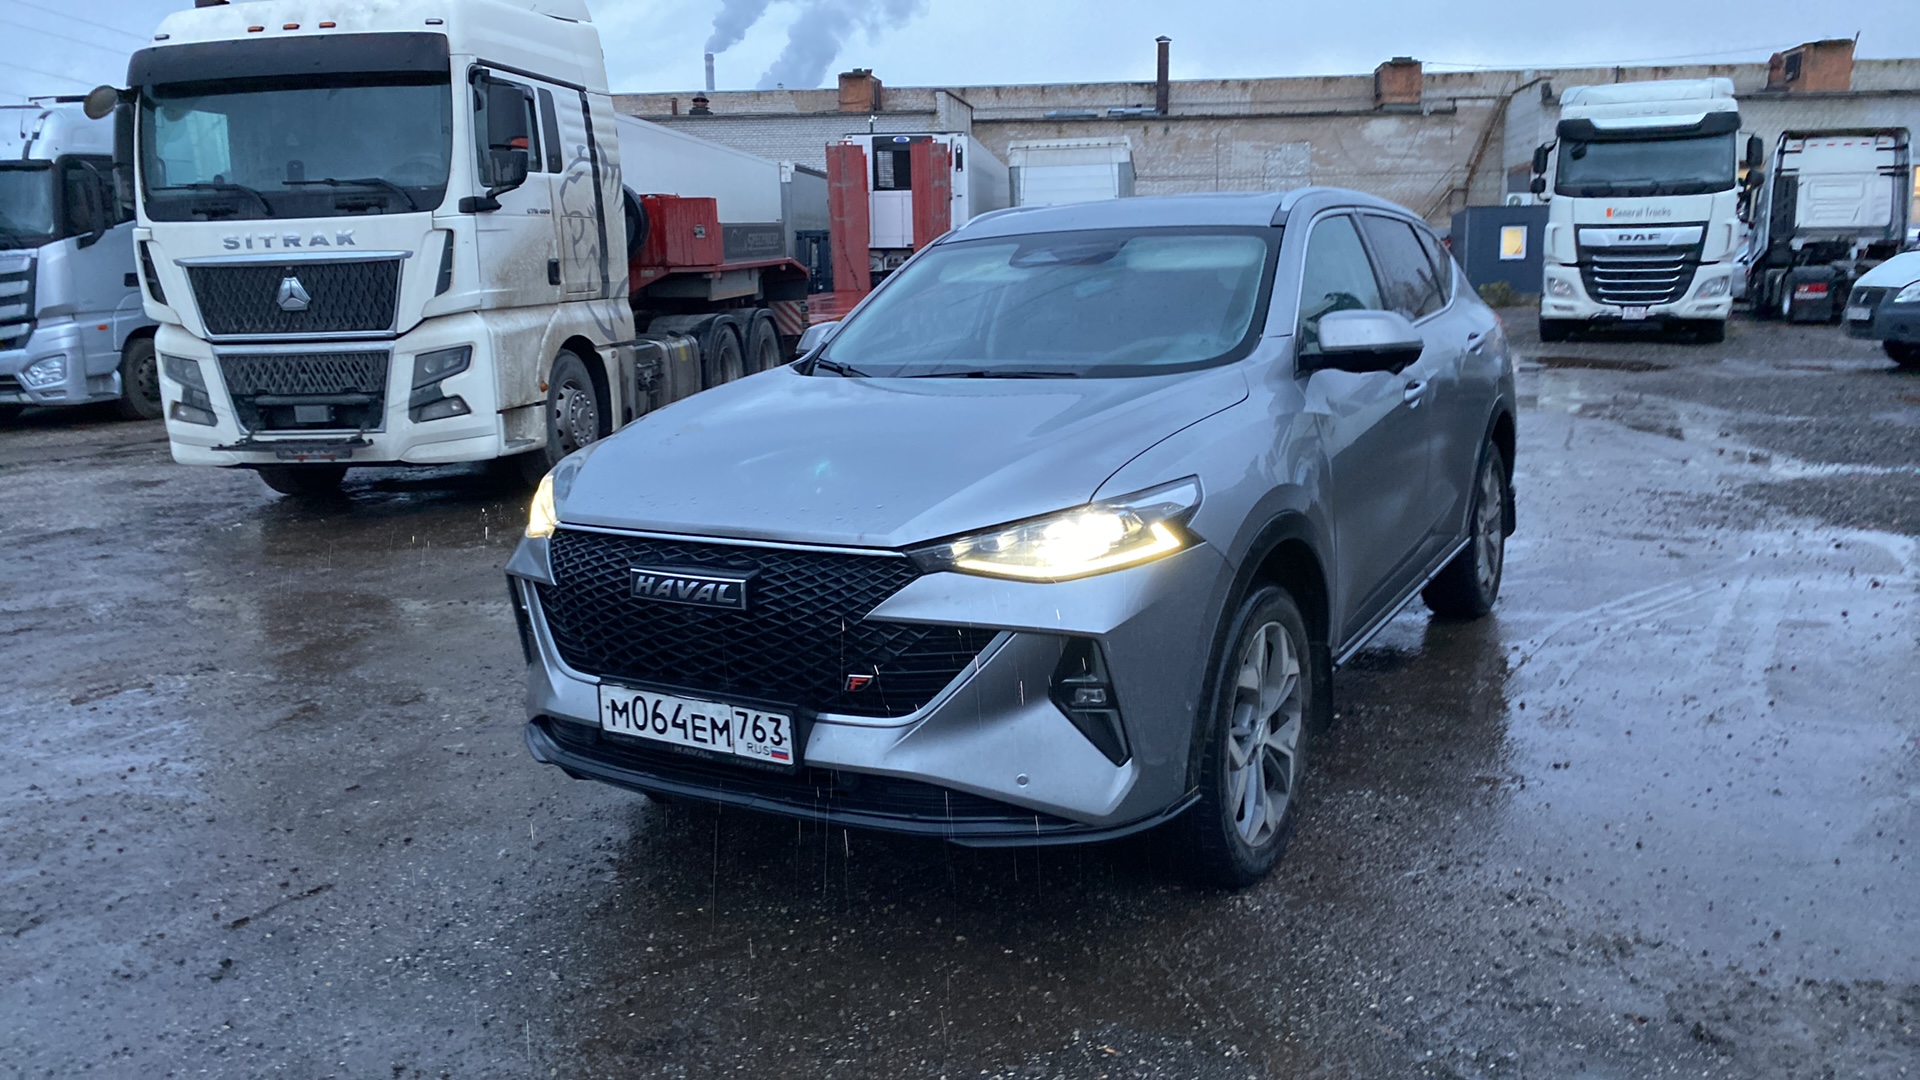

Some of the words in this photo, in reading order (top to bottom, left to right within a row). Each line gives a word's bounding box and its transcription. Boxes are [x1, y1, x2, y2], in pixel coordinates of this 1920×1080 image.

[222, 229, 356, 250] SITRAK
[1618, 233, 1661, 241] DAF
[634, 575, 737, 602] HAVAL
[746, 742, 770, 756] RUS
